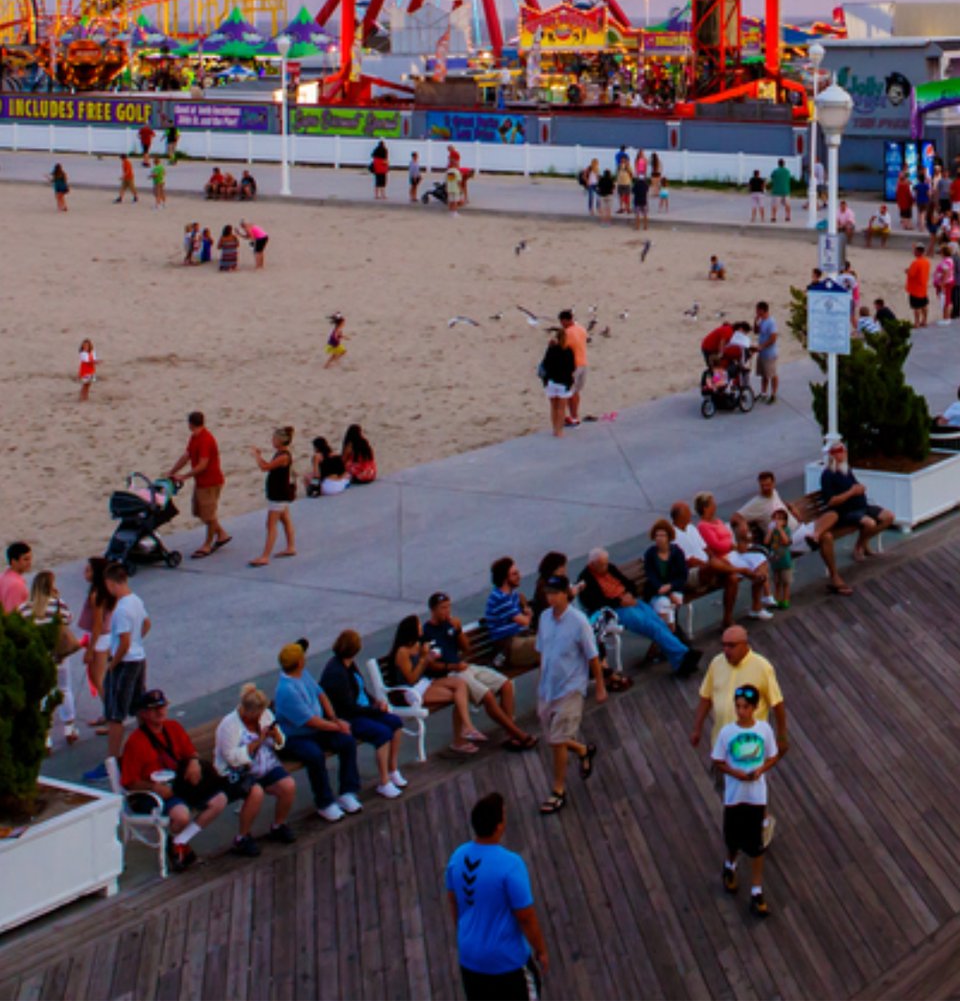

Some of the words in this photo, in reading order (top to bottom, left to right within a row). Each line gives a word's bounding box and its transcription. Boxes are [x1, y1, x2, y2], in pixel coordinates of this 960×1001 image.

[8, 98, 74, 120] INCLUDES
[78, 101, 111, 121] FREE
[116, 103, 152, 123] GOLF
